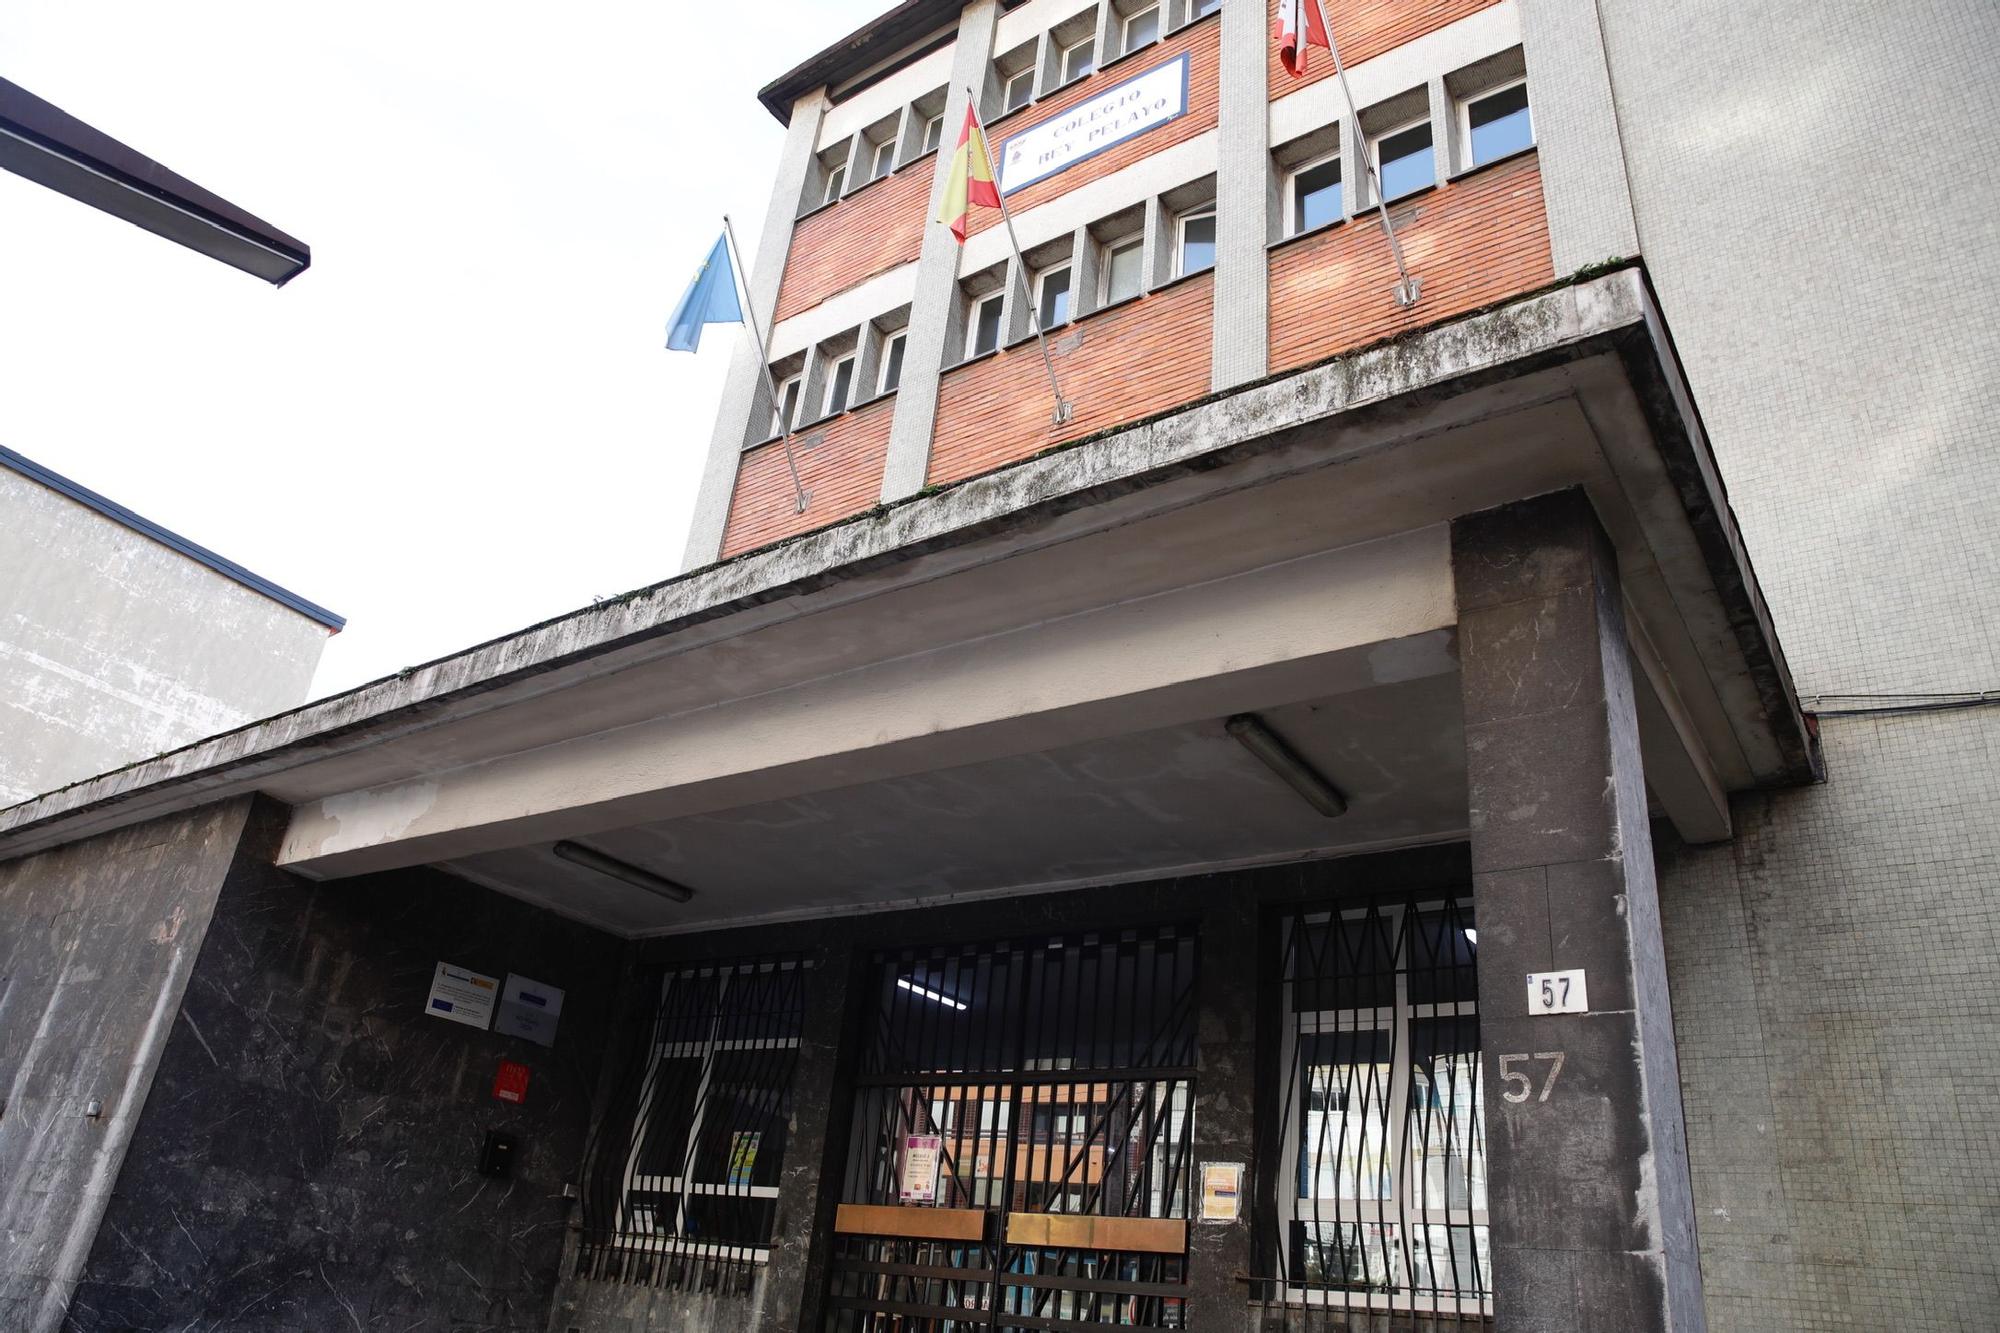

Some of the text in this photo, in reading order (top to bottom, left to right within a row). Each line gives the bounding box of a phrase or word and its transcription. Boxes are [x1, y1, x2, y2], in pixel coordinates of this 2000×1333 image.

[1053, 90, 1141, 138] COLEGIO
[1088, 98, 1167, 141] PELAYO
[1541, 977, 1570, 1009] 57
[1499, 1051, 1565, 1104] 57
